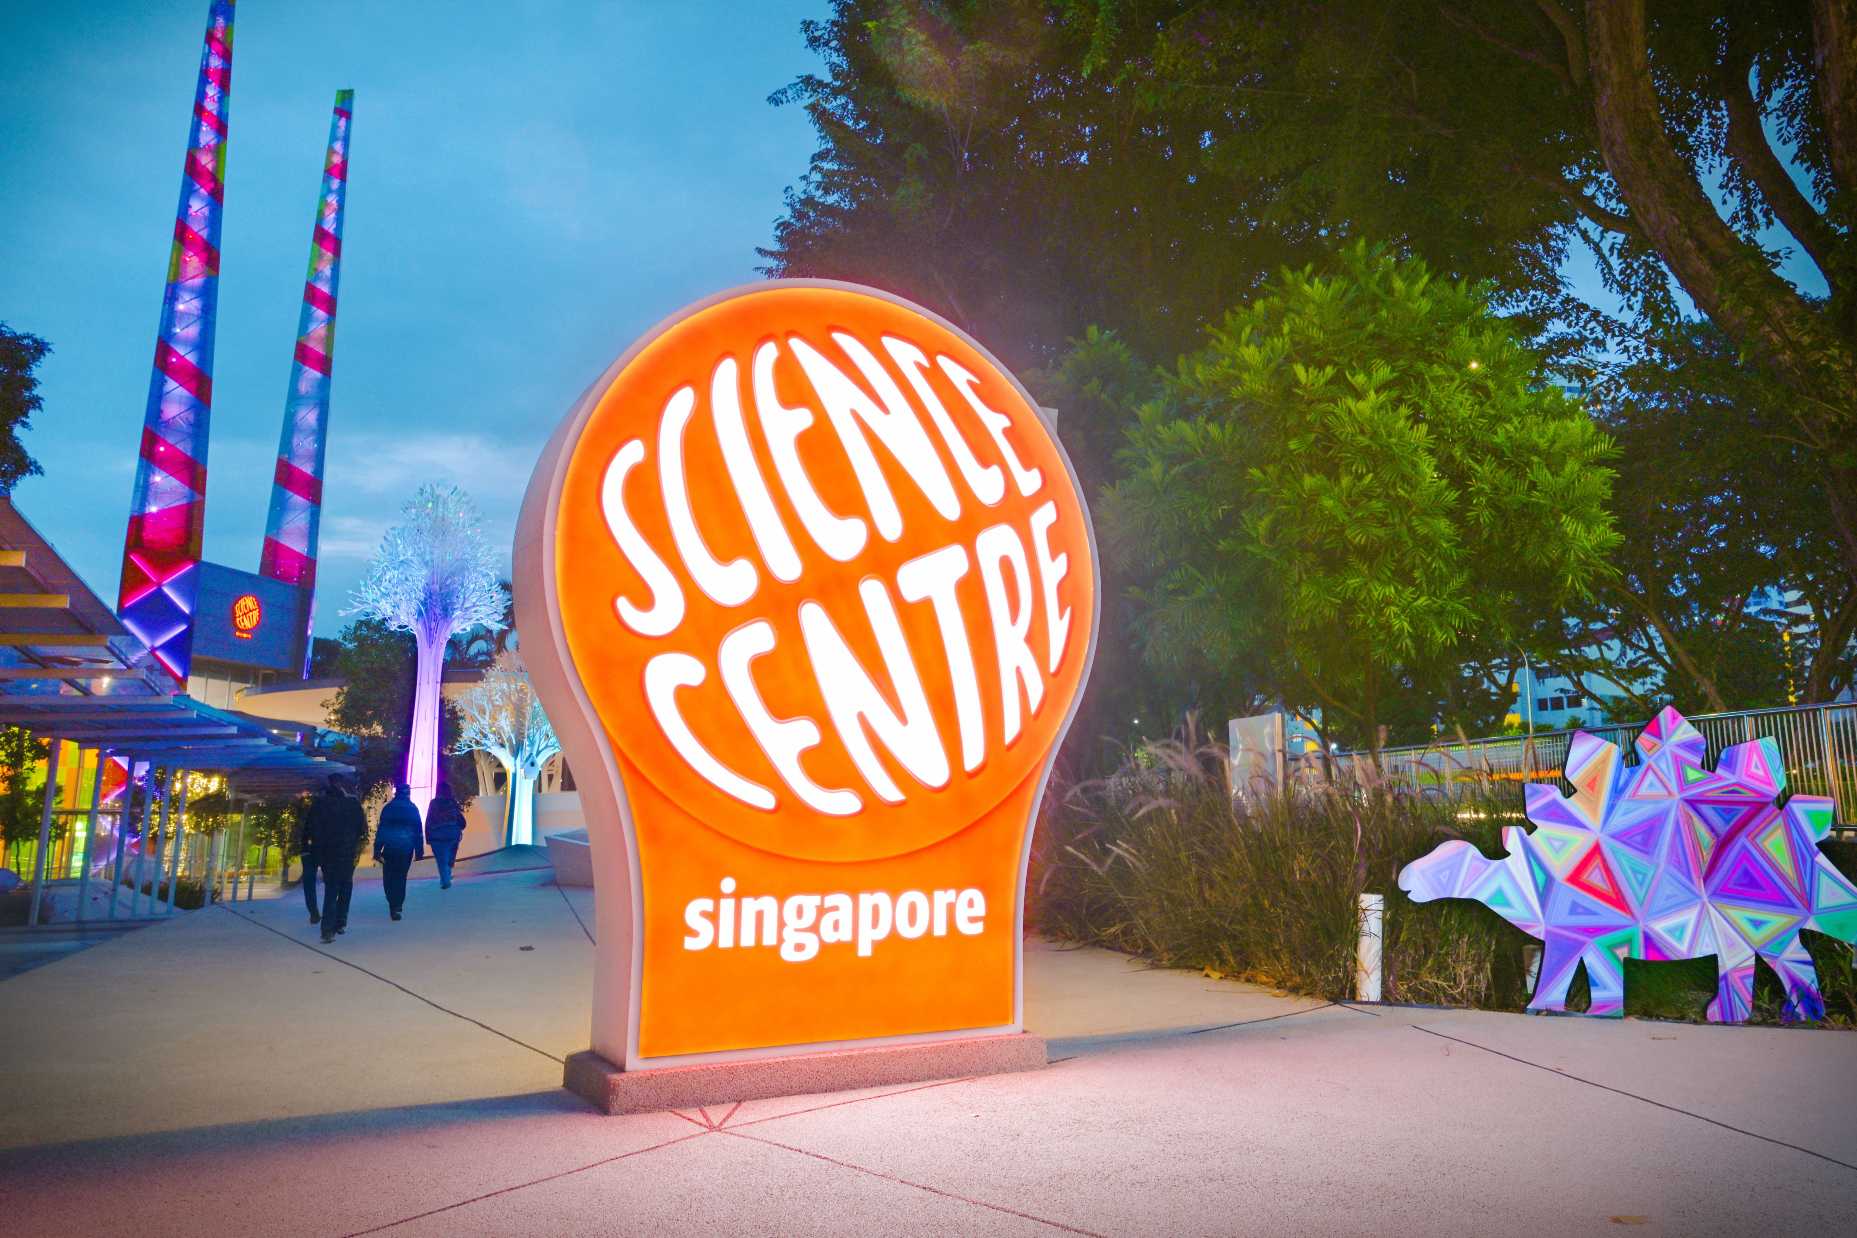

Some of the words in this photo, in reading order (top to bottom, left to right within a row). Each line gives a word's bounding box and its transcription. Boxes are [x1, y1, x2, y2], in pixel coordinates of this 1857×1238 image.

[602, 332, 1042, 637] SCIENCE
[644, 500, 1071, 815] CENTRE
[683, 876, 986, 962] singapore
